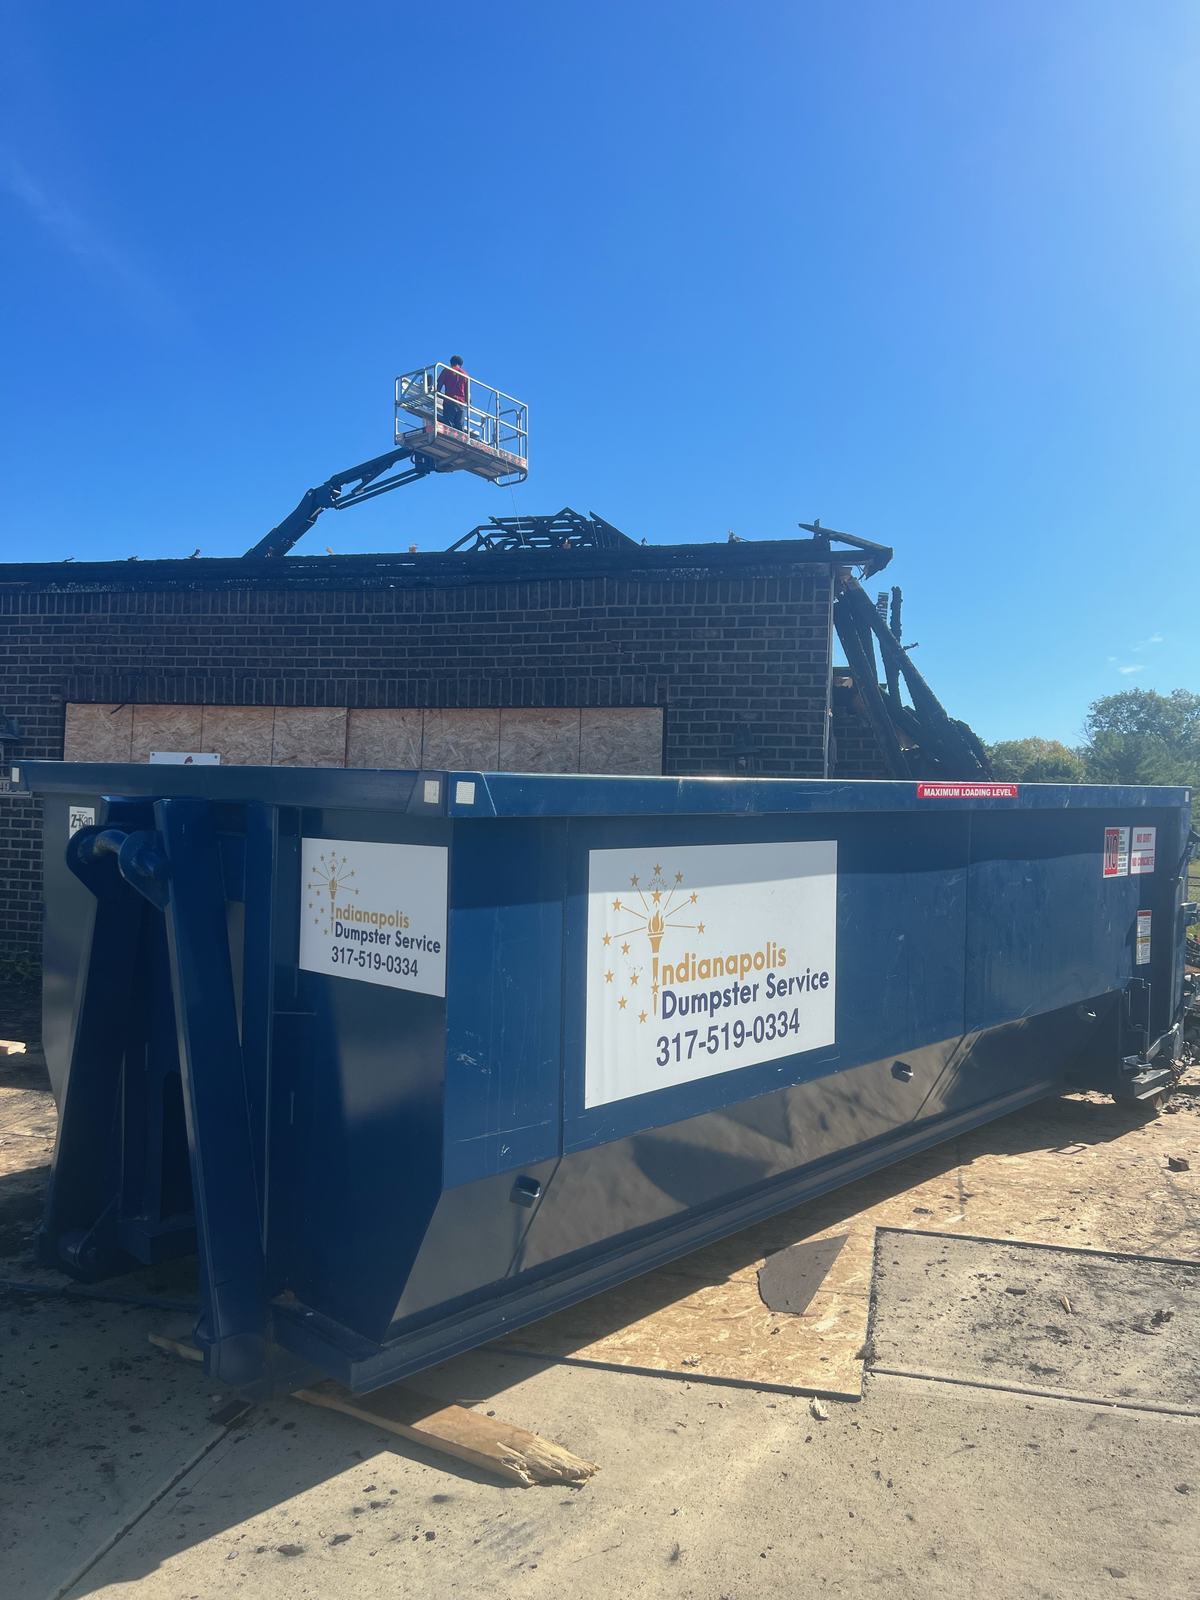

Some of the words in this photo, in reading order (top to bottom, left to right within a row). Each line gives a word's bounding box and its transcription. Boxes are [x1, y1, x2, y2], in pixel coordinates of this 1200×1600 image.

[924, 788, 960, 797] MAXIMUM
[961, 788, 991, 797] LOADING
[992, 788, 1012, 797] LEVEL
[330, 902, 410, 929] Indianapolis
[335, 921, 391, 946] Dumpster
[395, 930, 441, 953] Service
[331, 946, 418, 977] 317-519-0334
[652, 941, 787, 987] Indianapolis
[662, 981, 760, 1020] Dumpster
[766, 967, 830, 999] Service
[656, 1008, 801, 1067] 317-519-0334
